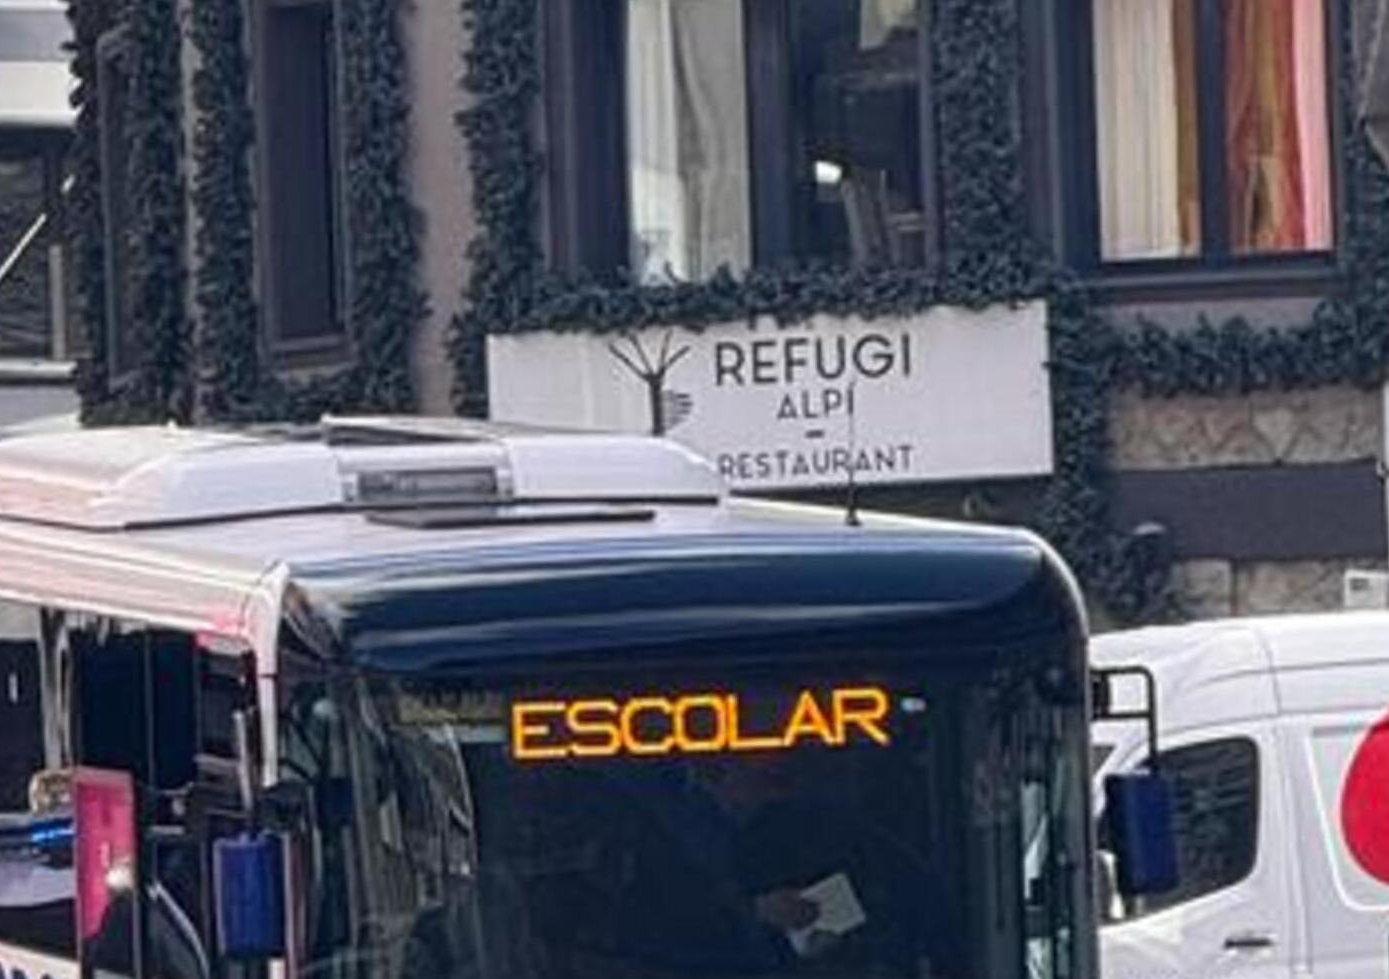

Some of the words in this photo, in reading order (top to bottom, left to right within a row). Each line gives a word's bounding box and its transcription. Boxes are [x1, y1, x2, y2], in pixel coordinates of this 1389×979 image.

[715, 335, 911, 387] REFUGI
[777, 388, 854, 419] ALPI
[717, 445, 914, 478] RESTAURANT
[511, 687, 891, 761] ESCOLAR
